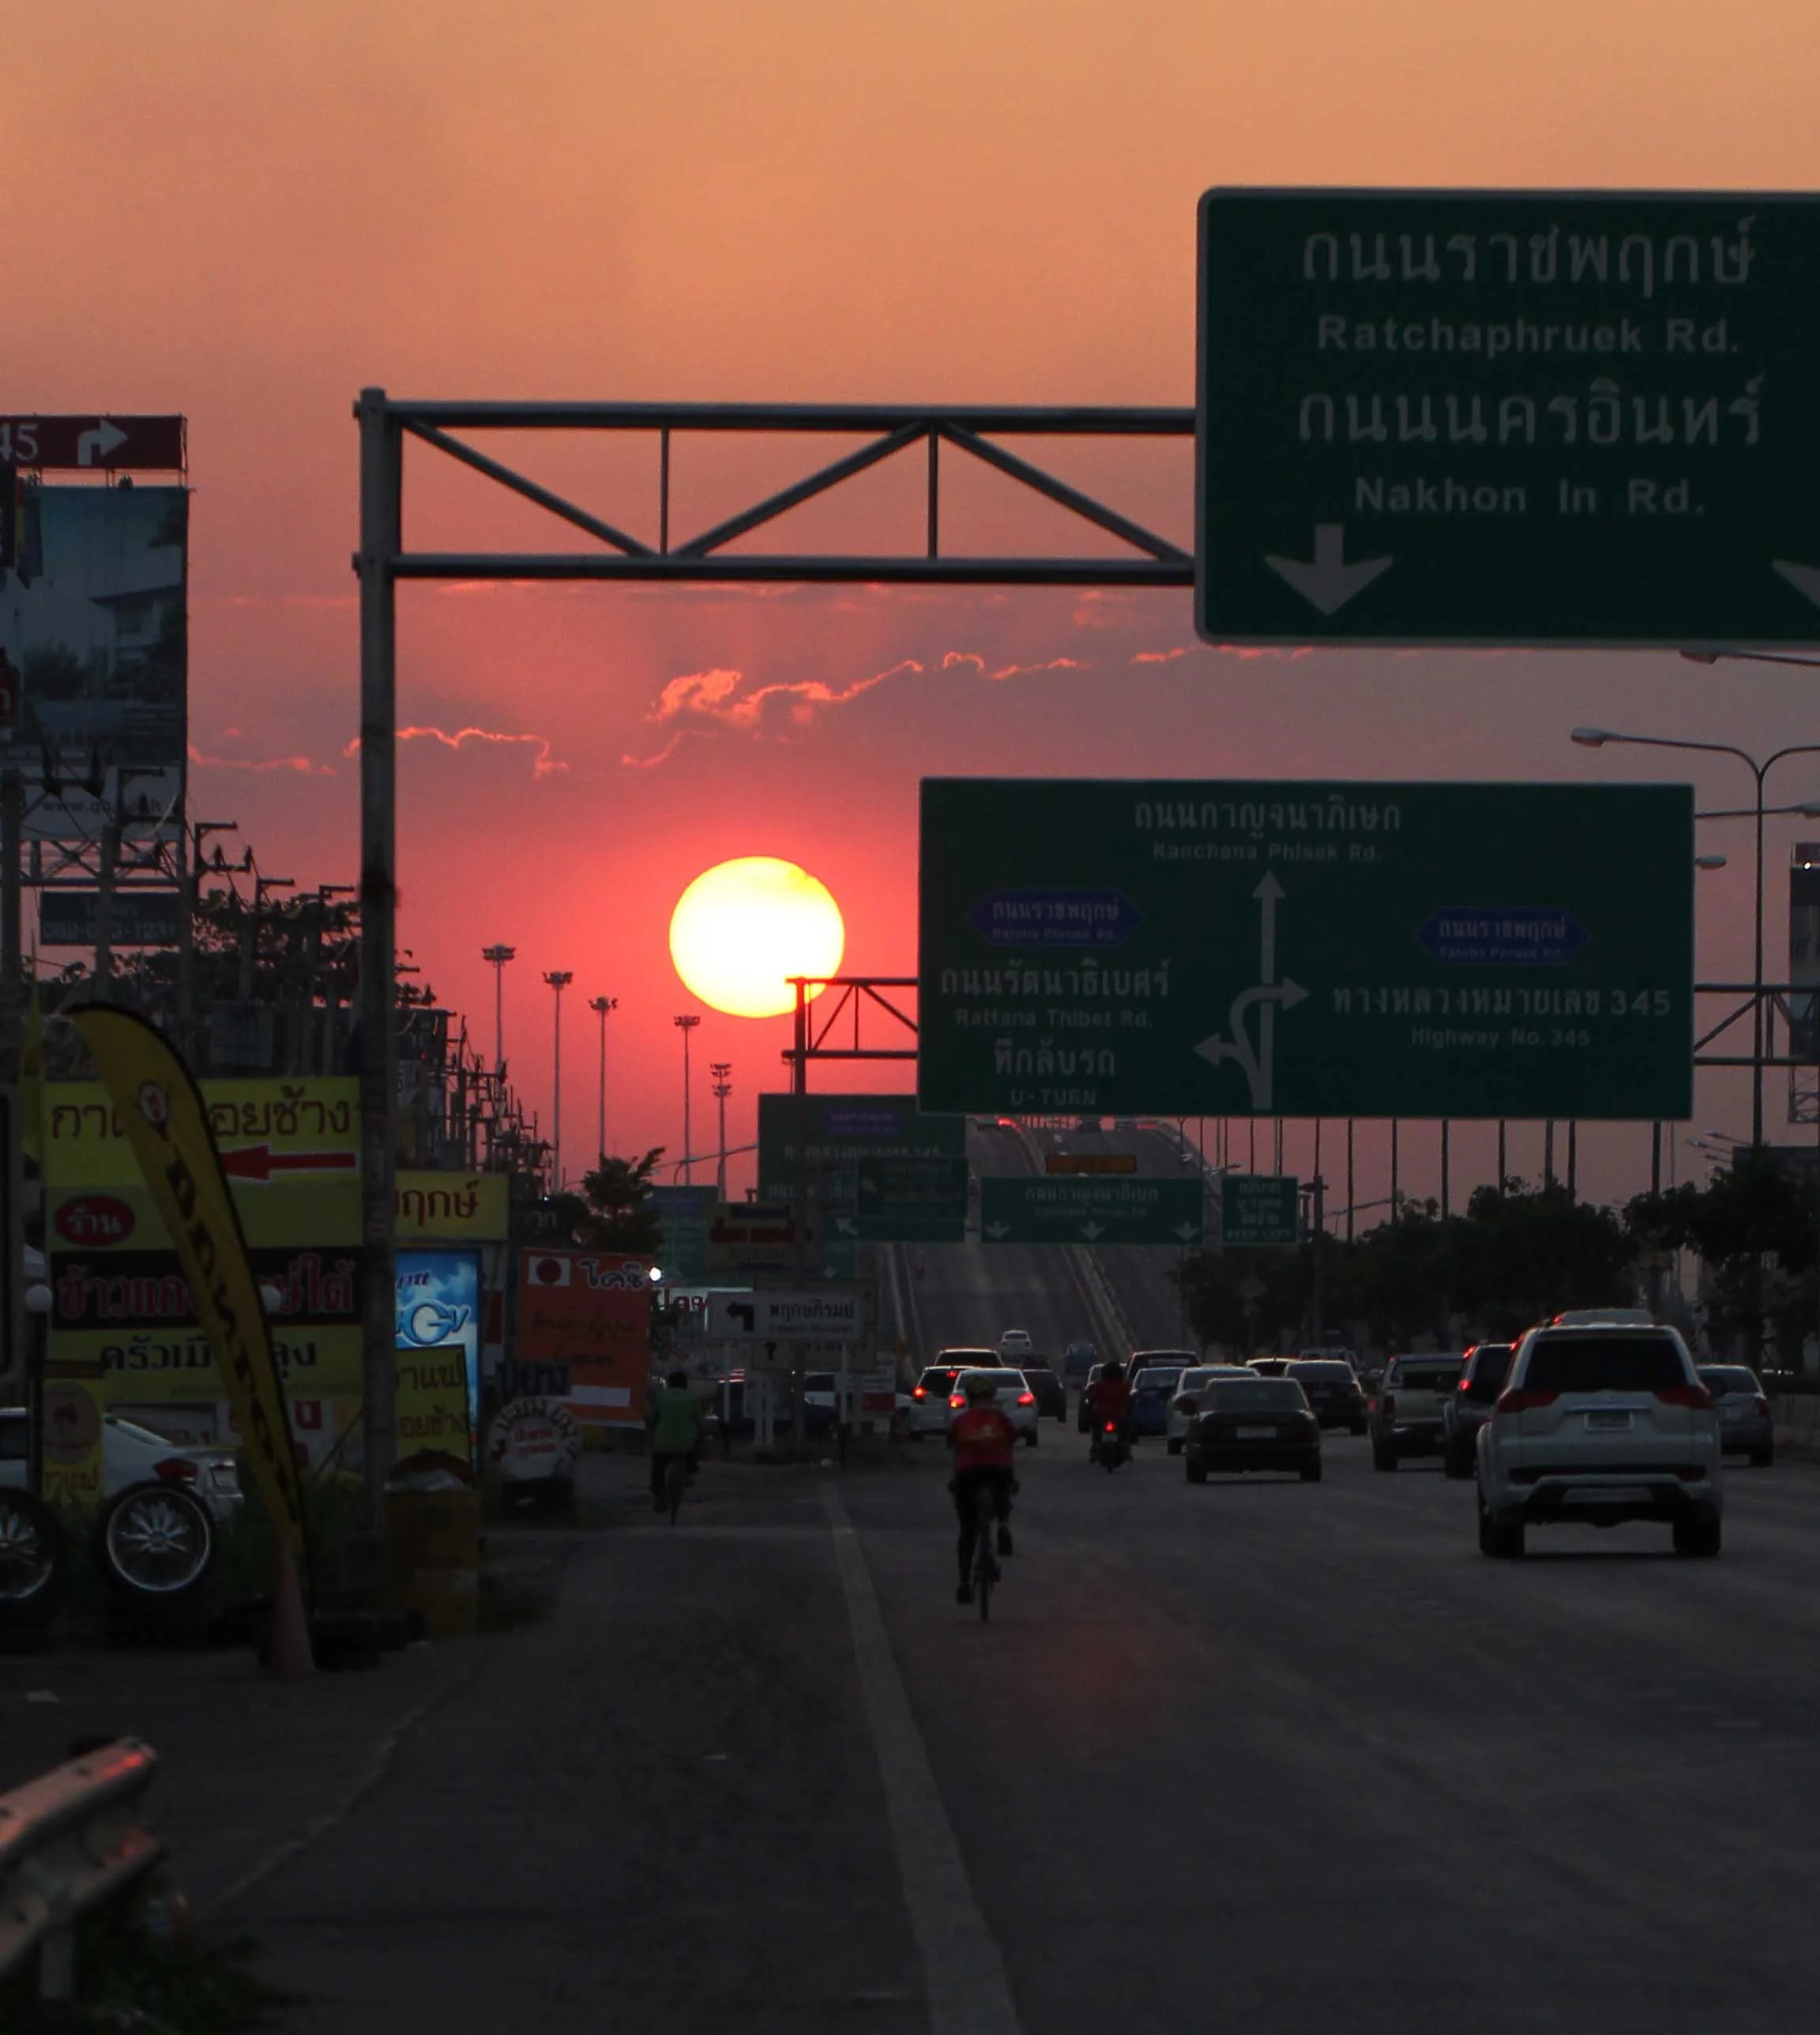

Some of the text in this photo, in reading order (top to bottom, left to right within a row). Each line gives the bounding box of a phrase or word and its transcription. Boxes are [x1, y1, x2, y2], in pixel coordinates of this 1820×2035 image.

[1303, 213, 1758, 298] ถนนราชพฤกษ์
[1317, 315, 1739, 359] Ratchaphruek Rd.
[1298, 373, 1765, 446] ถนนนครอินทร์
[1355, 477, 1706, 515] Nakhon In Rd.
[1134, 794, 1401, 840] ถนนกาญจนาภิเษก
[1153, 841, 1382, 863] Kanchana Phisek Rd.
[941, 957, 1171, 997] ถนนรัตนาธิเบศร์
[1120, 1010, 1154, 1029] Rd.
[1333, 987, 1671, 1018] ทางหลวงหมายเลข 345
[1411, 1028, 1500, 1049] Highway
[1009, 1088, 1097, 1108] U-TURN
[66, 1206, 123, 1234] ร้าน
